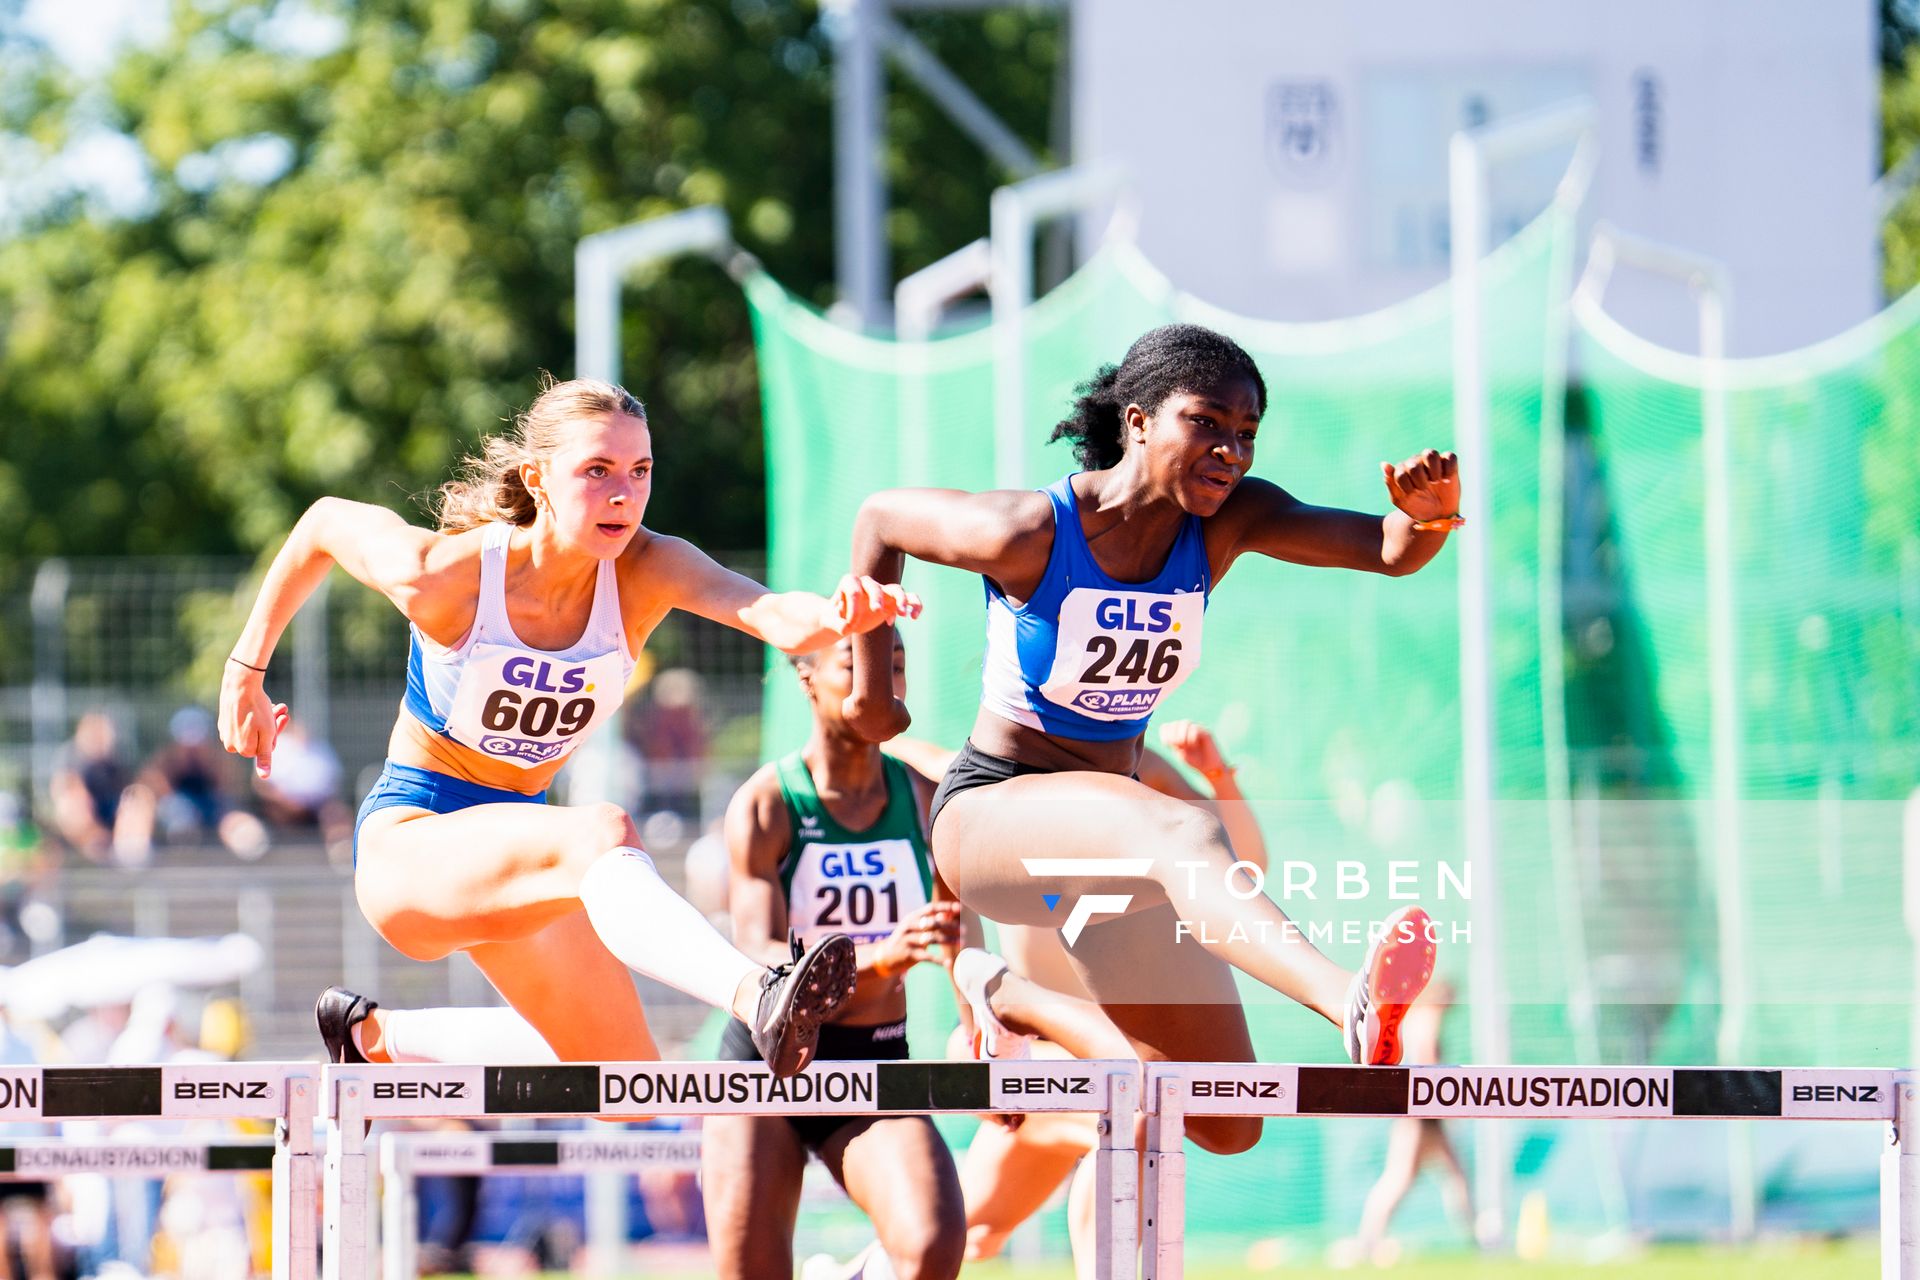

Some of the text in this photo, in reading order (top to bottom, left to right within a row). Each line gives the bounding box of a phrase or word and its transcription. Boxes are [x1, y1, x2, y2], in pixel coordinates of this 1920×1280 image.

[1079, 635, 1183, 685] 246
[481, 689, 596, 738] 609
[1110, 693, 1157, 706] PLAN
[814, 880, 899, 926] 201
[604, 1071, 873, 1105] DONAUSTADION
[1412, 1076, 1670, 1107] DONAUSTADION
[559, 1141, 702, 1162] DONAUSTADI
